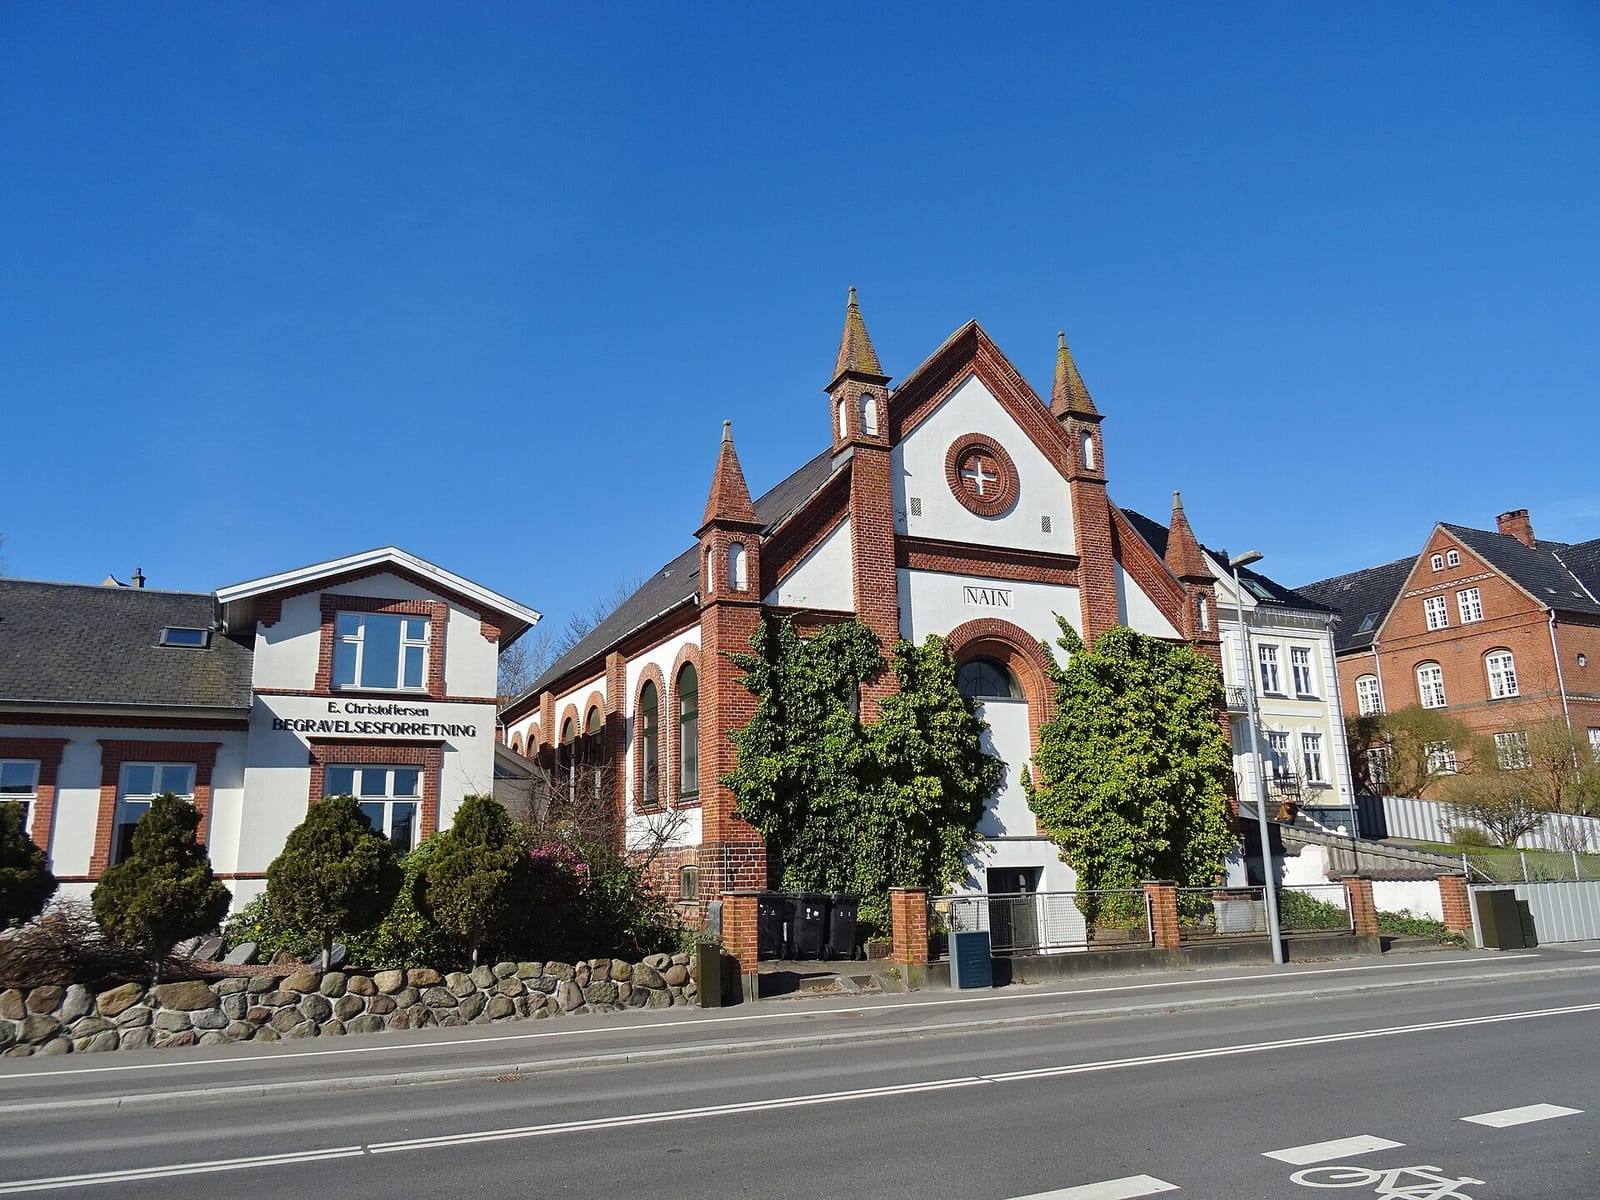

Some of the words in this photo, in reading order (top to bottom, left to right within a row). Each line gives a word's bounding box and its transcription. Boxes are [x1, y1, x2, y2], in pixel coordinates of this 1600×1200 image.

[966, 588, 1009, 607] NAIN
[327, 701, 341, 714] E.
[344, 702, 430, 717] Christoffersen
[272, 718, 477, 737] BEGRAVELSESFORRETNING
